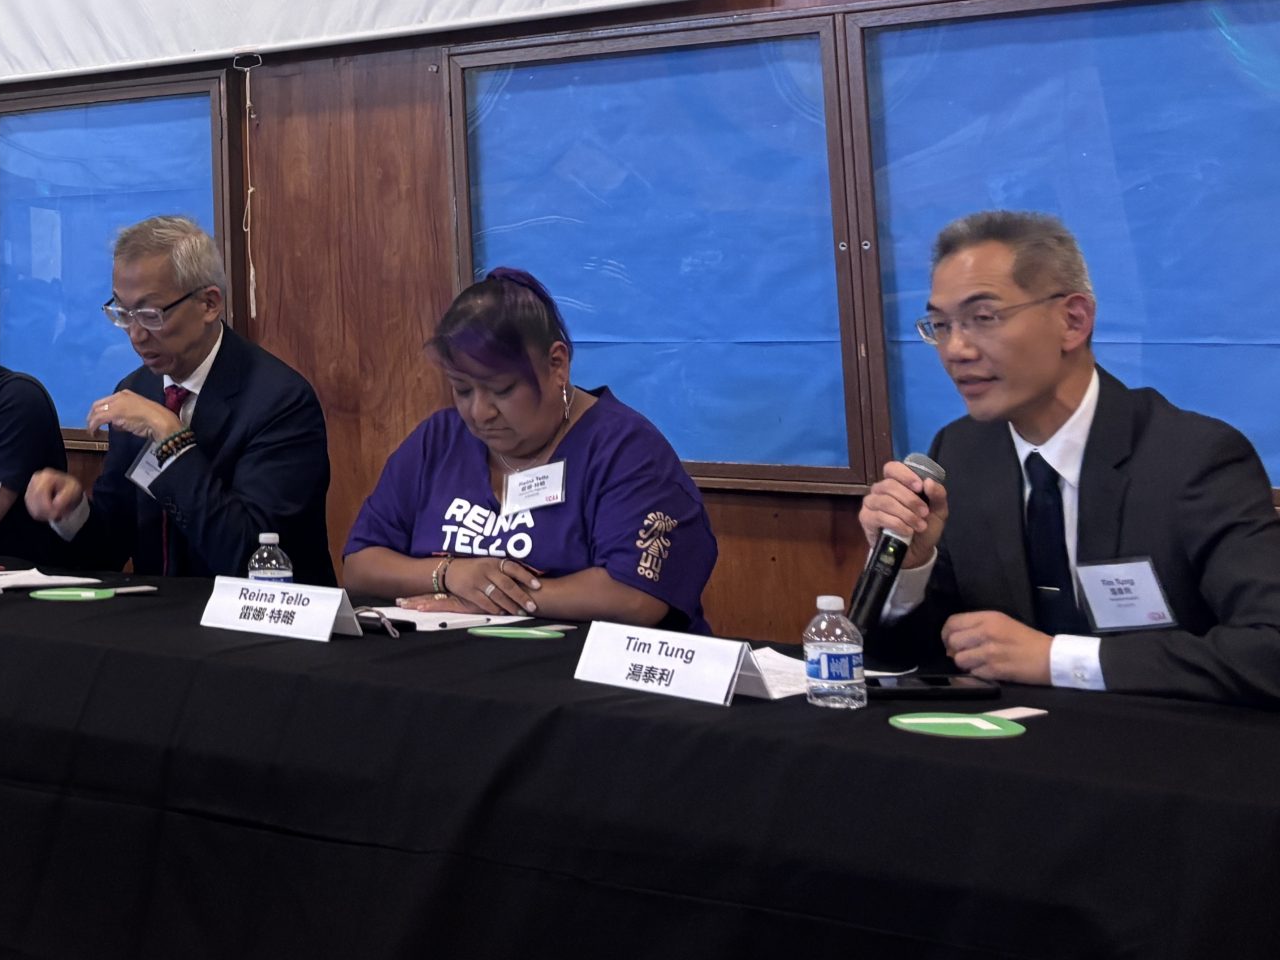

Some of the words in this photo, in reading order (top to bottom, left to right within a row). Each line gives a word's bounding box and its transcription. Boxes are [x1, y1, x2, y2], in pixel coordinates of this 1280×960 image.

[444, 497, 535, 537] REINA
[441, 525, 533, 559] TELLO
[238, 587, 275, 603] Reina
[280, 591, 310, 607] Tello
[625, 636, 652, 654] Tim
[657, 640, 696, 664] Tung
